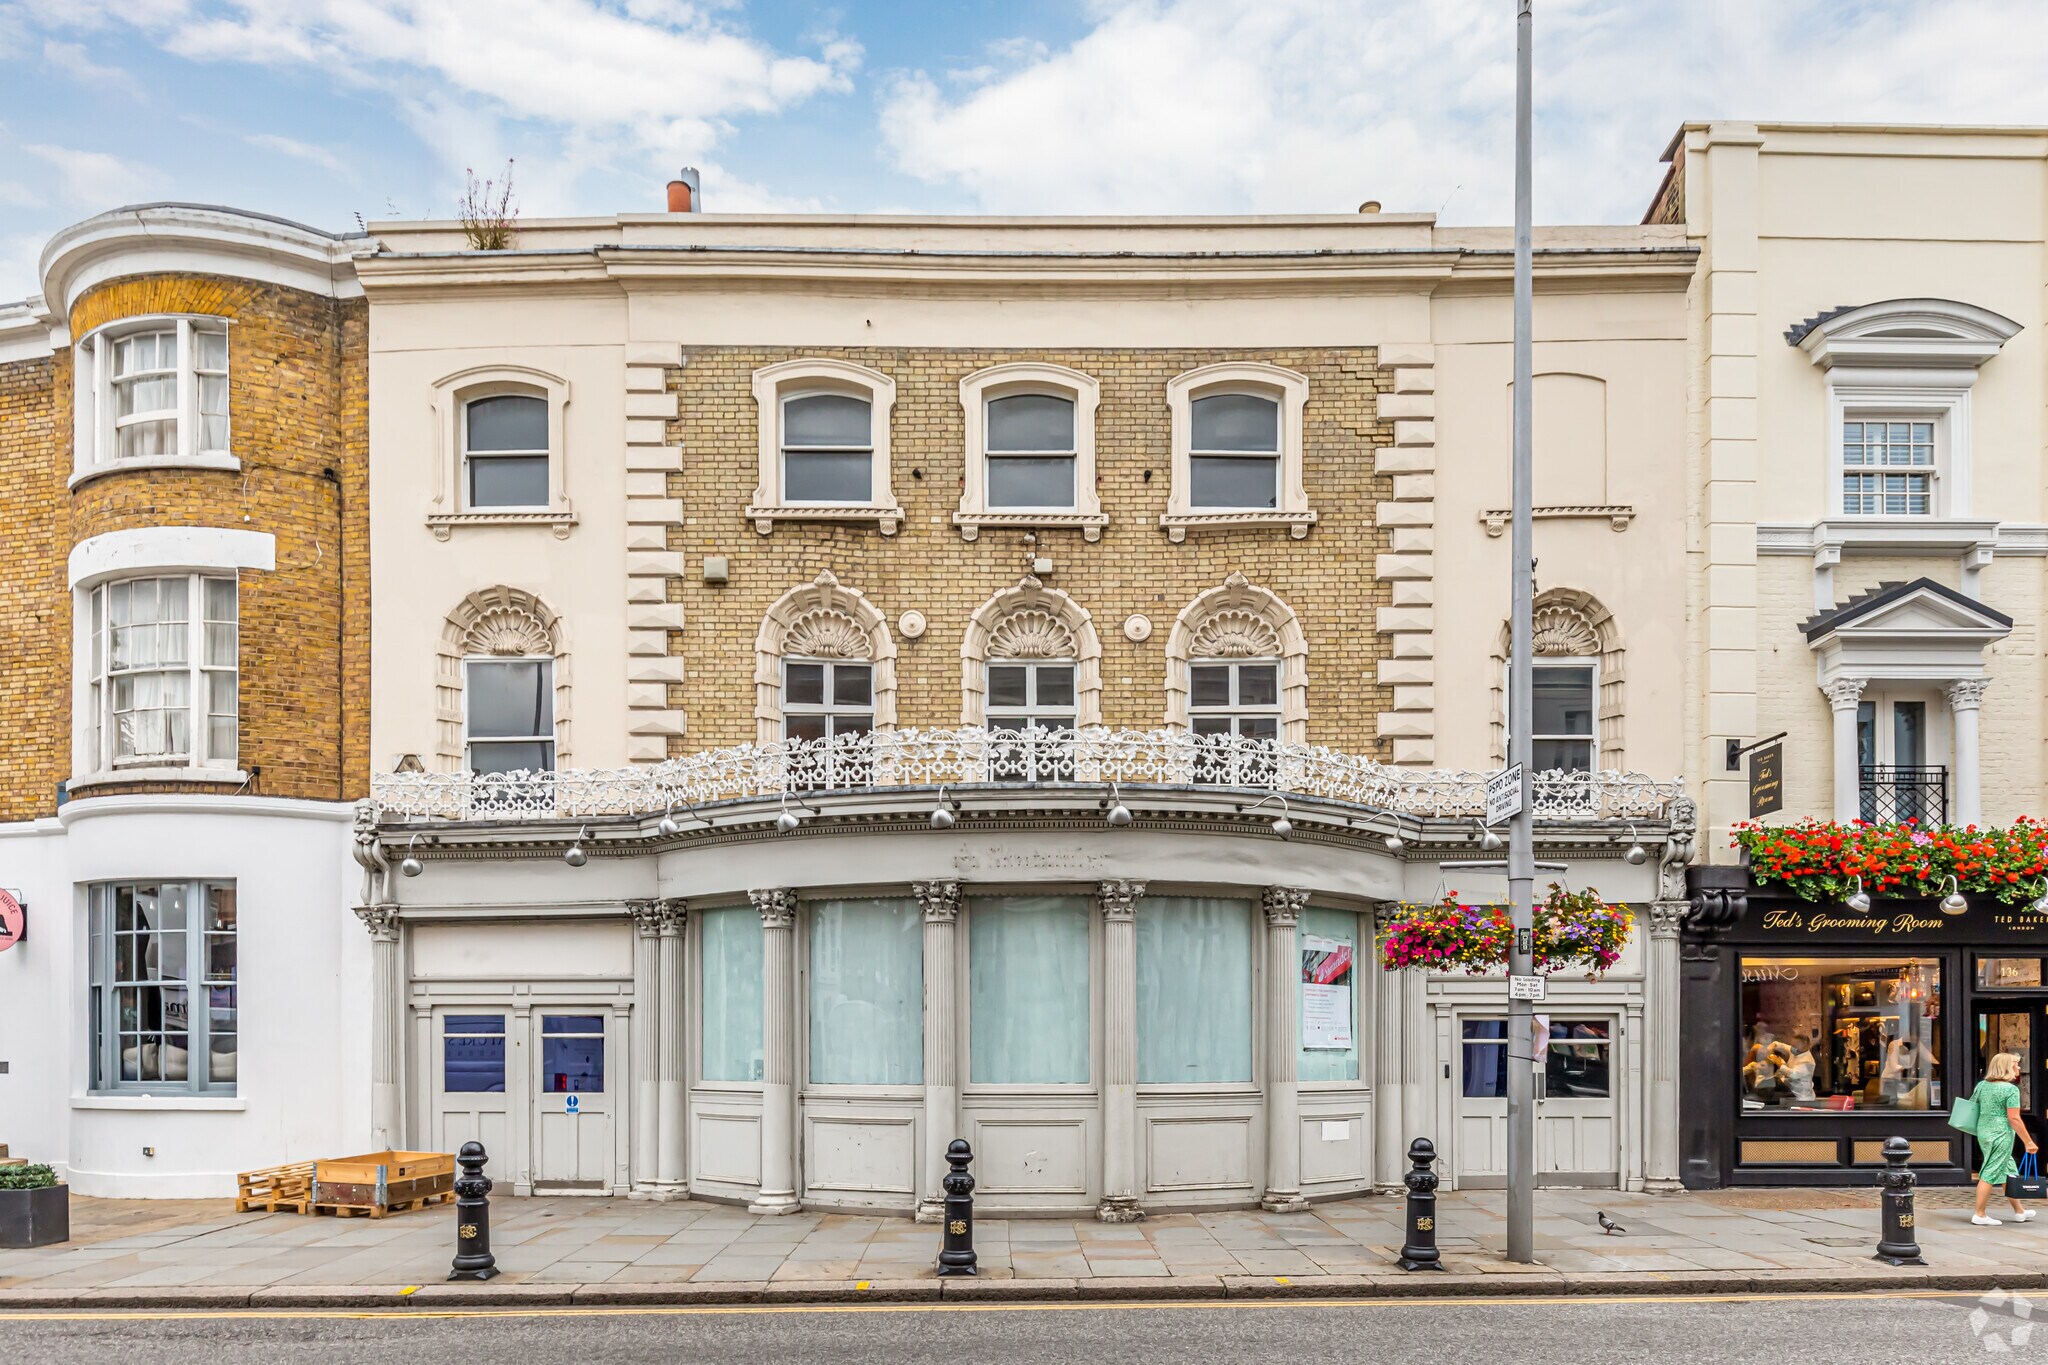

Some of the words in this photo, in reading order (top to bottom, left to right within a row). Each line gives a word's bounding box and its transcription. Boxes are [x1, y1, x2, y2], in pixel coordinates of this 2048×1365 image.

[1488, 779, 1503, 795] PSPO
[1505, 769, 1520, 787] ZONE
[1496, 799, 1512, 813] DRIVING
[1762, 909, 1803, 930] Ted's
[1807, 913, 1888, 934] Grooming
[1891, 913, 1944, 933] Room
[1994, 915, 2013, 923] TED
[2001, 966, 2019, 977] 136
